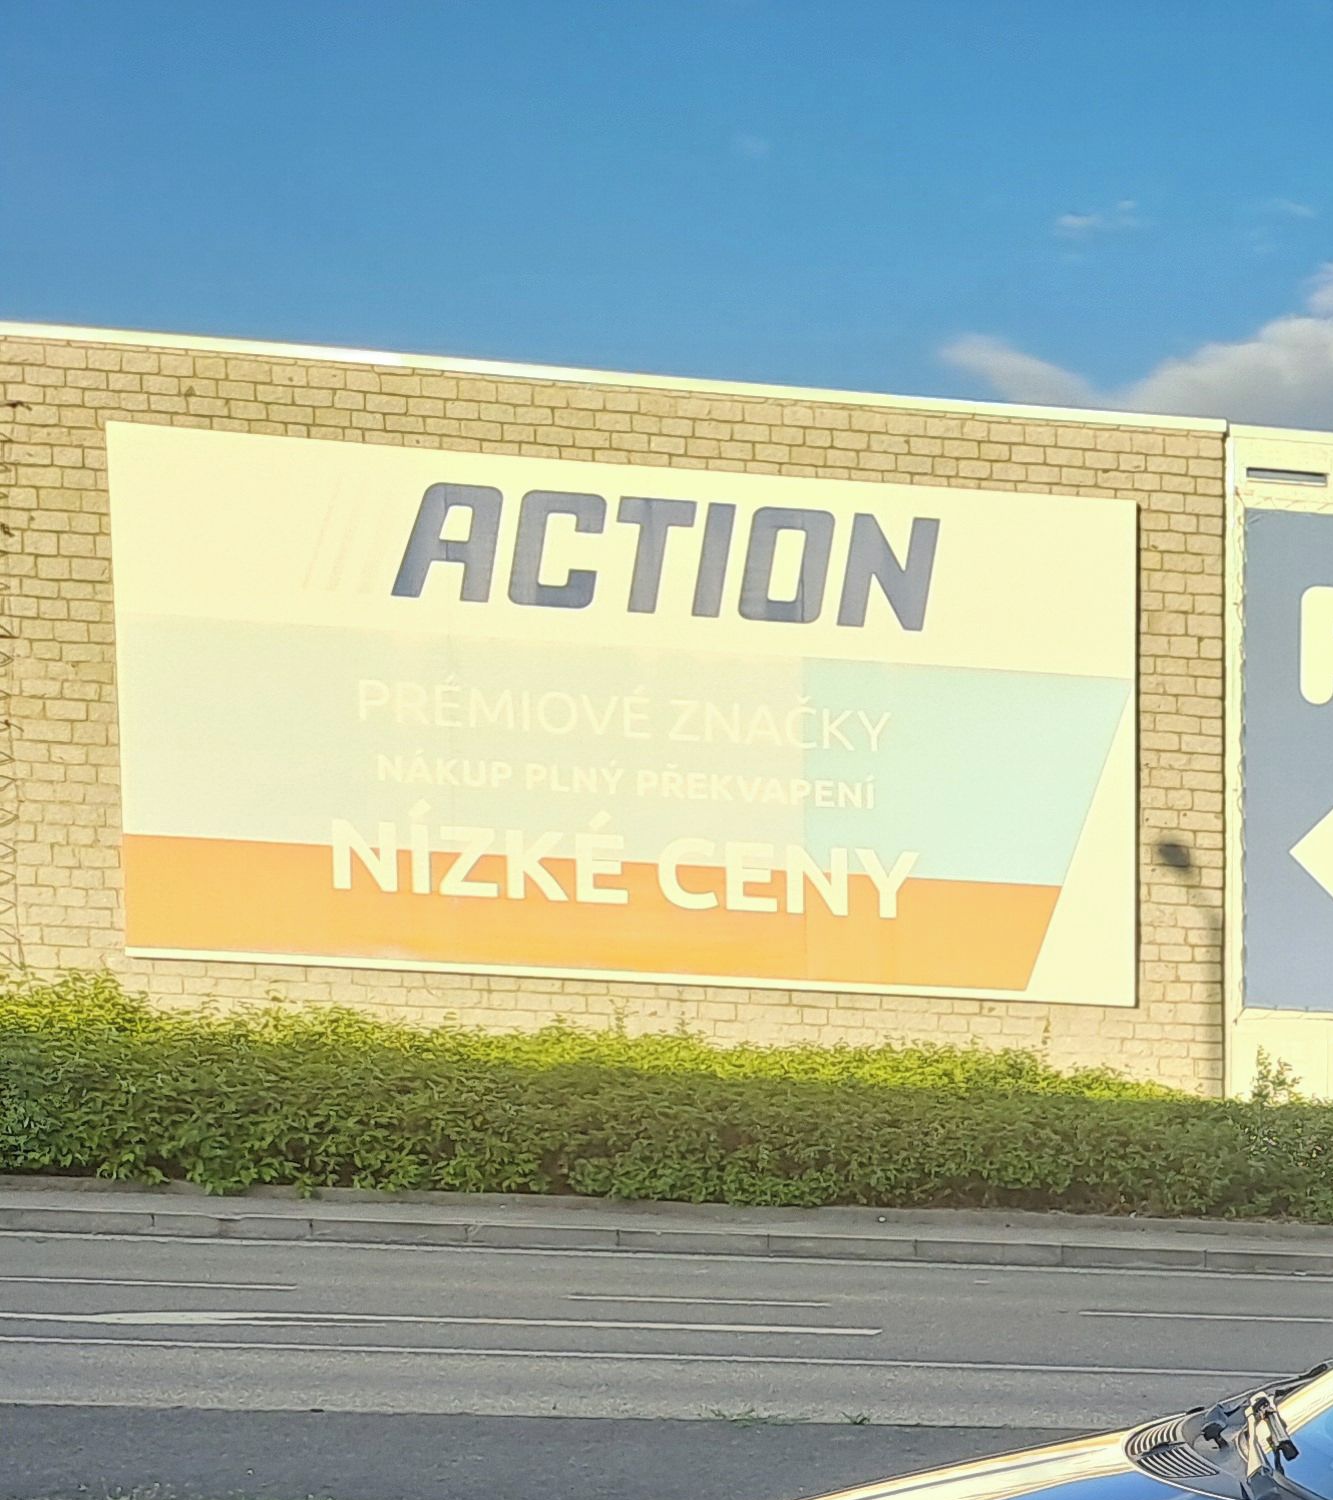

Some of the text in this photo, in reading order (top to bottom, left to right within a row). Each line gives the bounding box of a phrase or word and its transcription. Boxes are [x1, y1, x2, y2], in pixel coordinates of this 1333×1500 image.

[390, 481, 940, 632] ACTION
[356, 673, 892, 753] PRÉMIOVÉ ZNAČKY
[376, 748, 877, 811] NÁKUP PLNÝ PŘEKVAPENÍ
[330, 798, 921, 921] NÍZKÉ CENY
